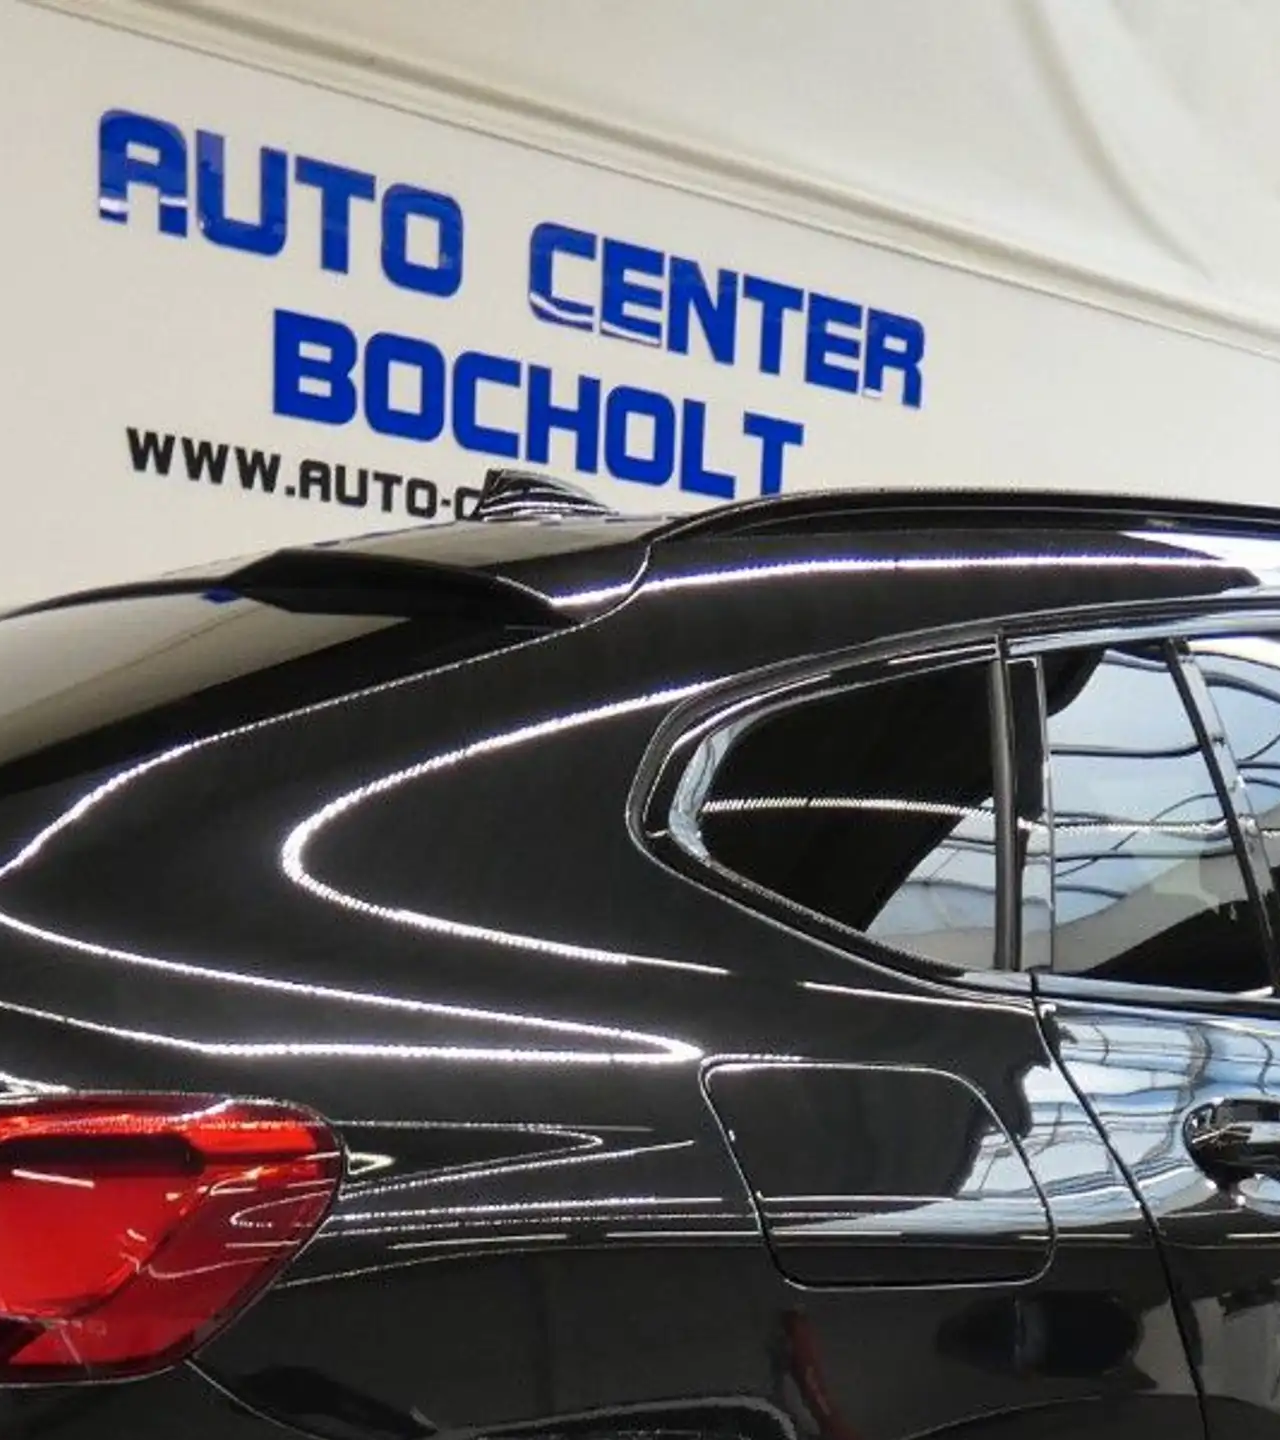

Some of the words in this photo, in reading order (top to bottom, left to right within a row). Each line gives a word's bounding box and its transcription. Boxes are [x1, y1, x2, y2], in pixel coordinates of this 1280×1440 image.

[98, 107, 464, 298] AUTO
[528, 221, 926, 409] CENTER
[272, 308, 805, 500] BOCHOLT
